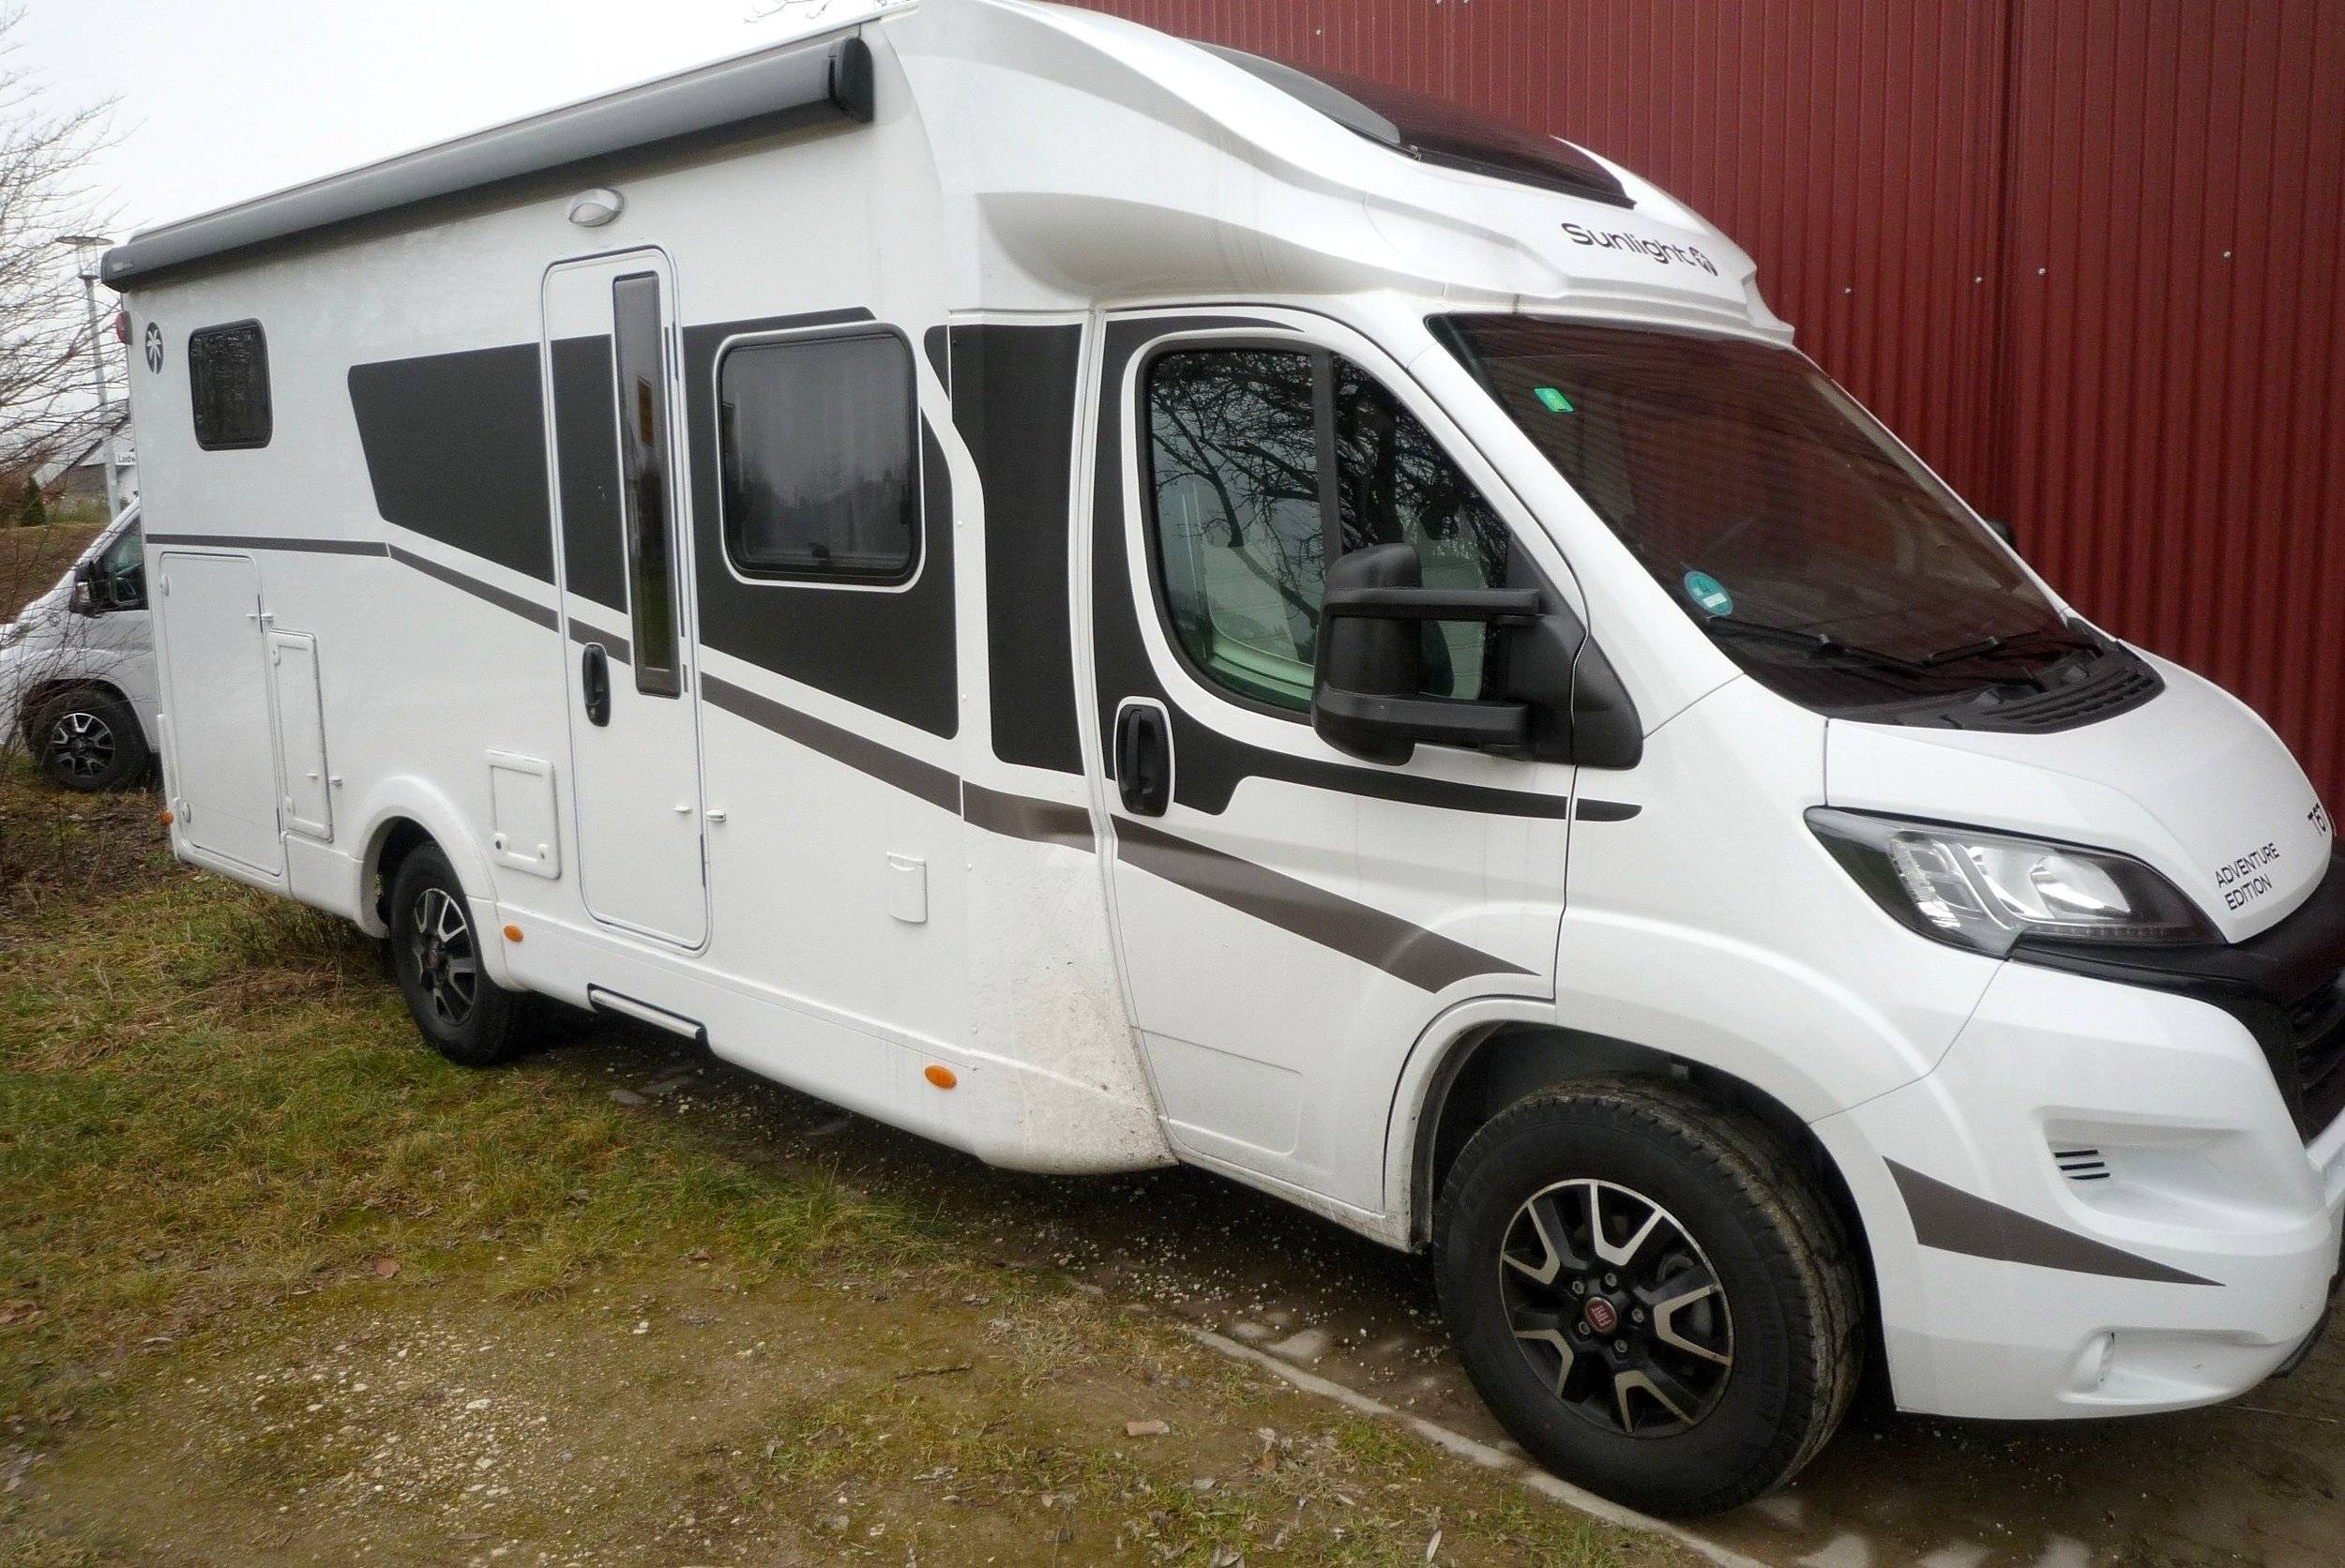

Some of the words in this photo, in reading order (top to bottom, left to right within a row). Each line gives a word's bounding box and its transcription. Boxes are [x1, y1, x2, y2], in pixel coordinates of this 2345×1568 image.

[1561, 222, 1696, 266] Sunlight
[2215, 842, 2280, 889] ADVENTURE
[2224, 874, 2273, 912] EDITION
